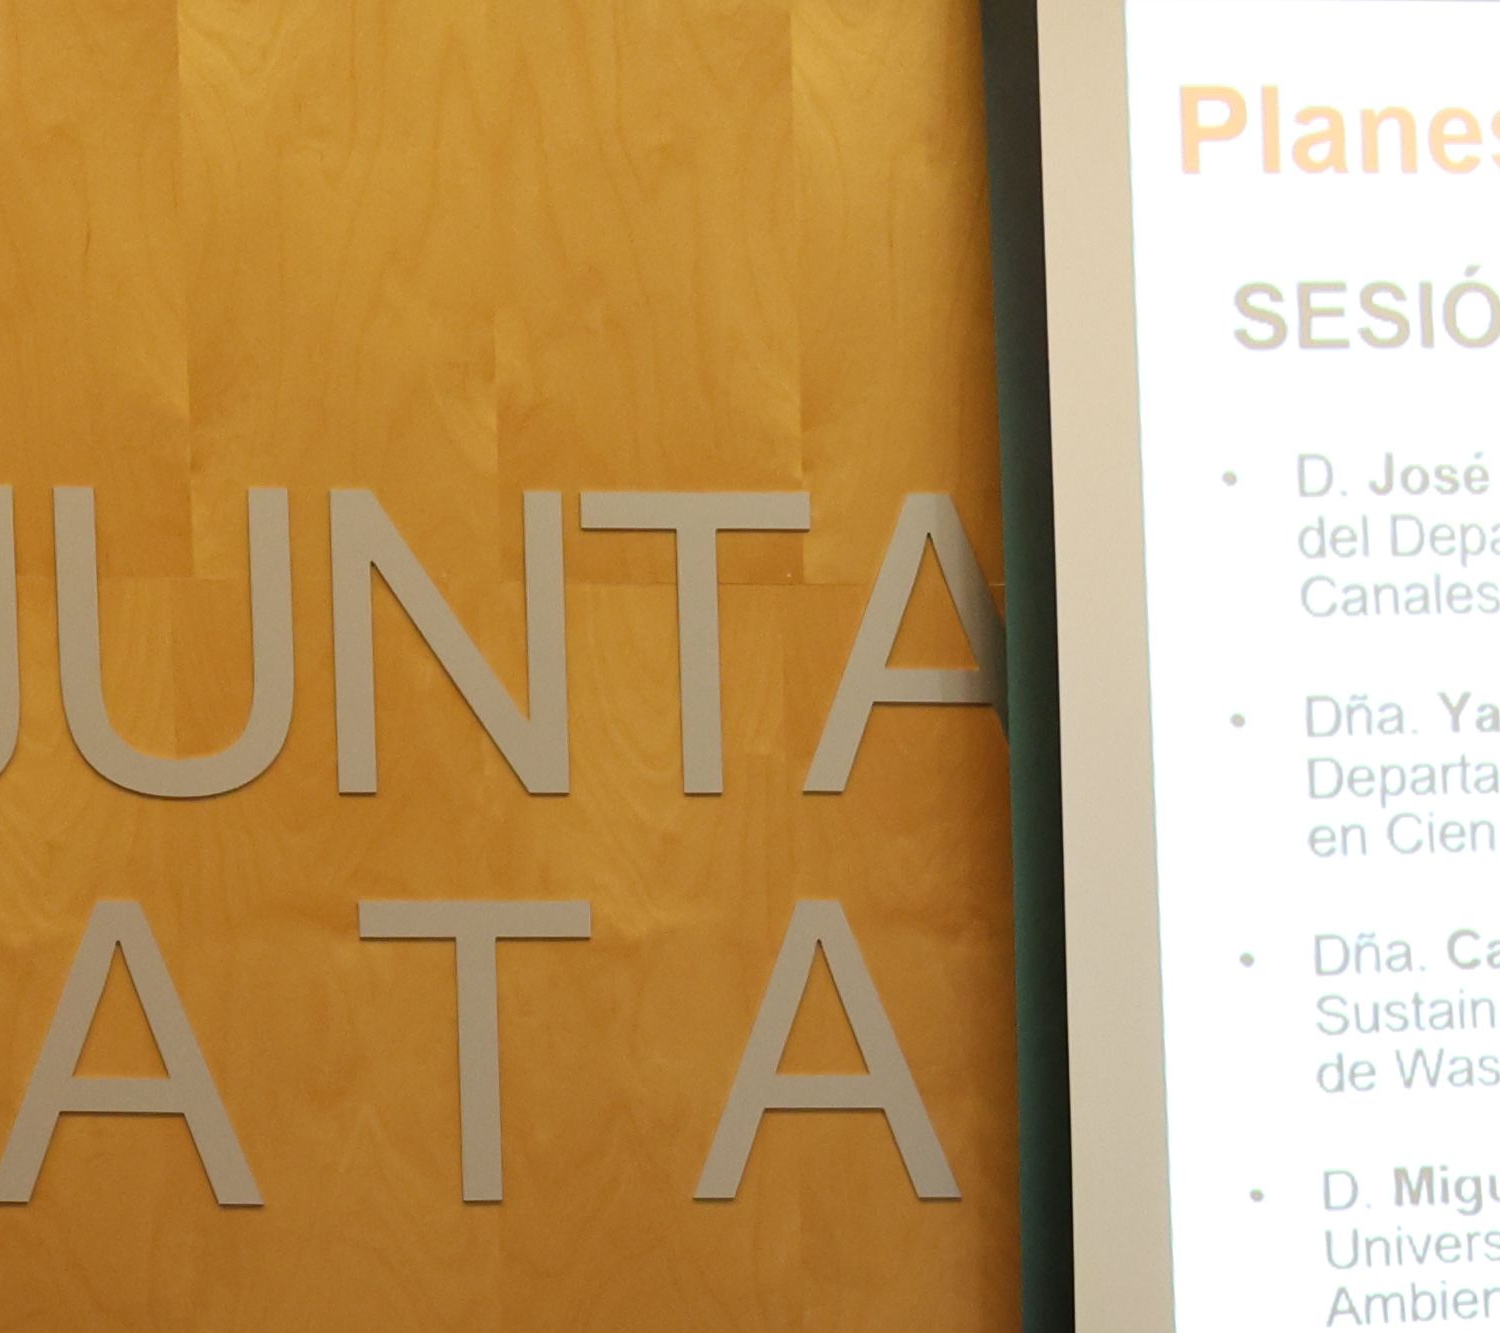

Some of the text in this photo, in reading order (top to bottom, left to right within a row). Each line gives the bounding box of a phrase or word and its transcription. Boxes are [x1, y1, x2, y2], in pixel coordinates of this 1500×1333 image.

[1297, 453, 1348, 497] D.
[1368, 451, 1490, 496] José
[1298, 514, 1369, 559] del
[1301, 572, 1500, 617] Canales
[1306, 693, 1418, 738] Dña.
[1307, 823, 1367, 858] en
[1314, 931, 1427, 976] Dña.
[1316, 1051, 1376, 1093] de
[1323, 1168, 1371, 1211] D.
